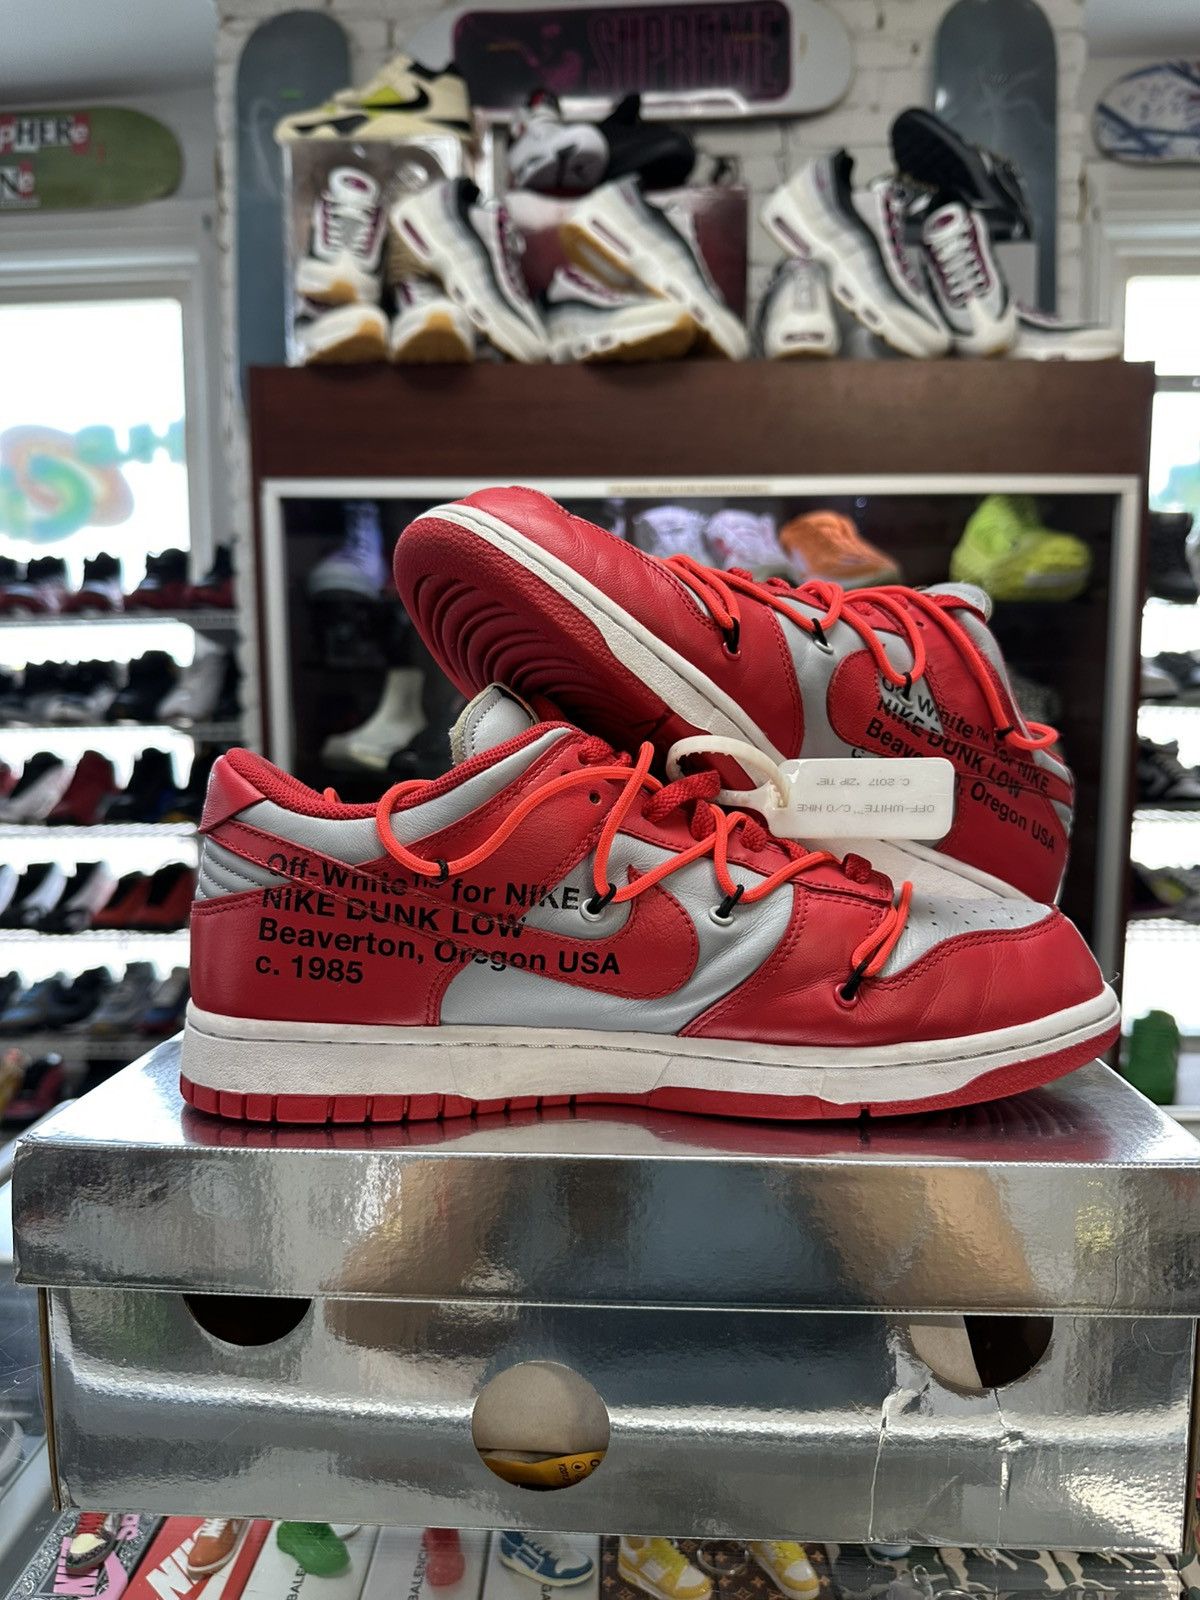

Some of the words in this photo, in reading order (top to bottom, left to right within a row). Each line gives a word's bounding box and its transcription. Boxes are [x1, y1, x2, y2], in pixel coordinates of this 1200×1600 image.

[588, 9, 778, 93] SUPREME
[877, 696, 924, 738] NIKE
[927, 727, 987, 774] DUNK
[988, 764, 1023, 799] LOW
[867, 777, 896, 787] 2017
[1016, 764, 1050, 796] NIKE
[796, 803, 823, 813] NIKE
[970, 781, 1028, 831] Oregon
[1031, 819, 1056, 851] USA
[262, 887, 336, 918] NIKE
[346, 896, 440, 932] DUNK
[451, 910, 526, 939] LOW
[451, 879, 497, 904] for
[504, 882, 580, 912] NIKE
[258, 916, 425, 964] Beaverton,
[434, 941, 547, 972] Oregon
[558, 950, 621, 975] USA
[255, 955, 280, 976] c.
[291, 954, 364, 985] 1985
